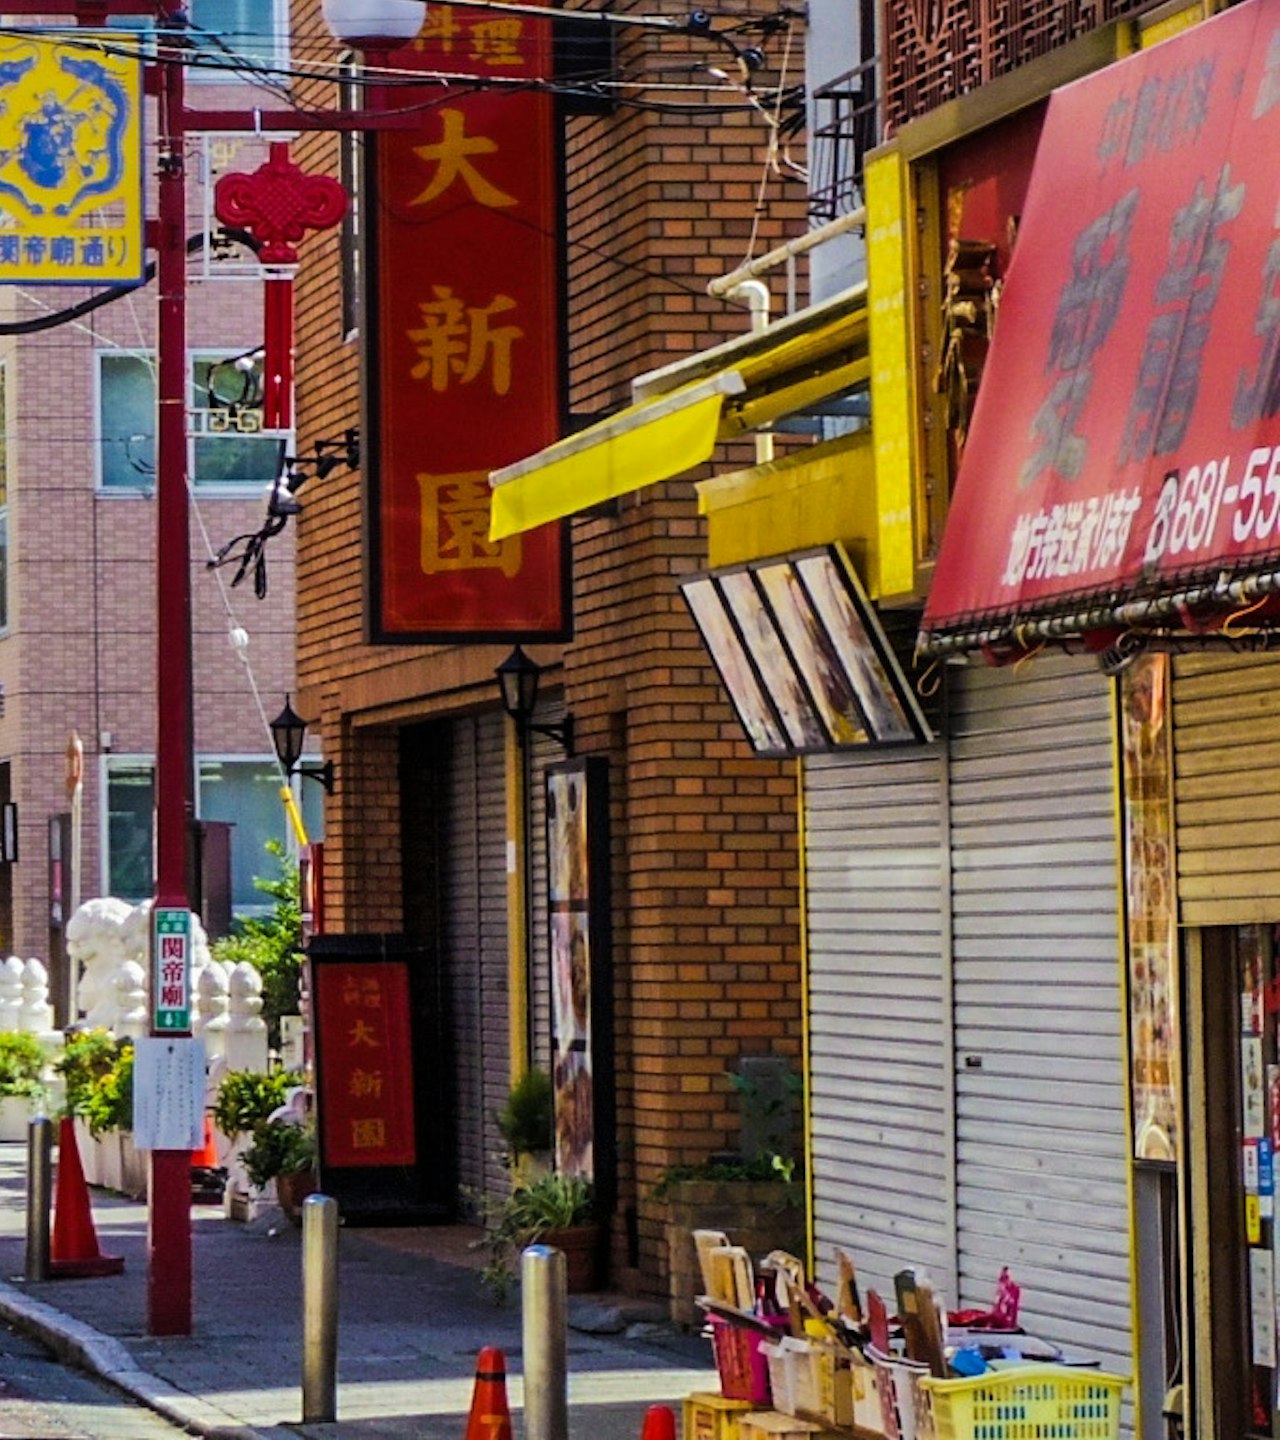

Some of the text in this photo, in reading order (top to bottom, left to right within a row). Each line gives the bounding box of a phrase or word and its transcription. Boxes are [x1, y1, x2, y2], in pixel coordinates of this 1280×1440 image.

[407, 108, 528, 580] 大新園
[160, 936, 186, 1008] 関帝廟
